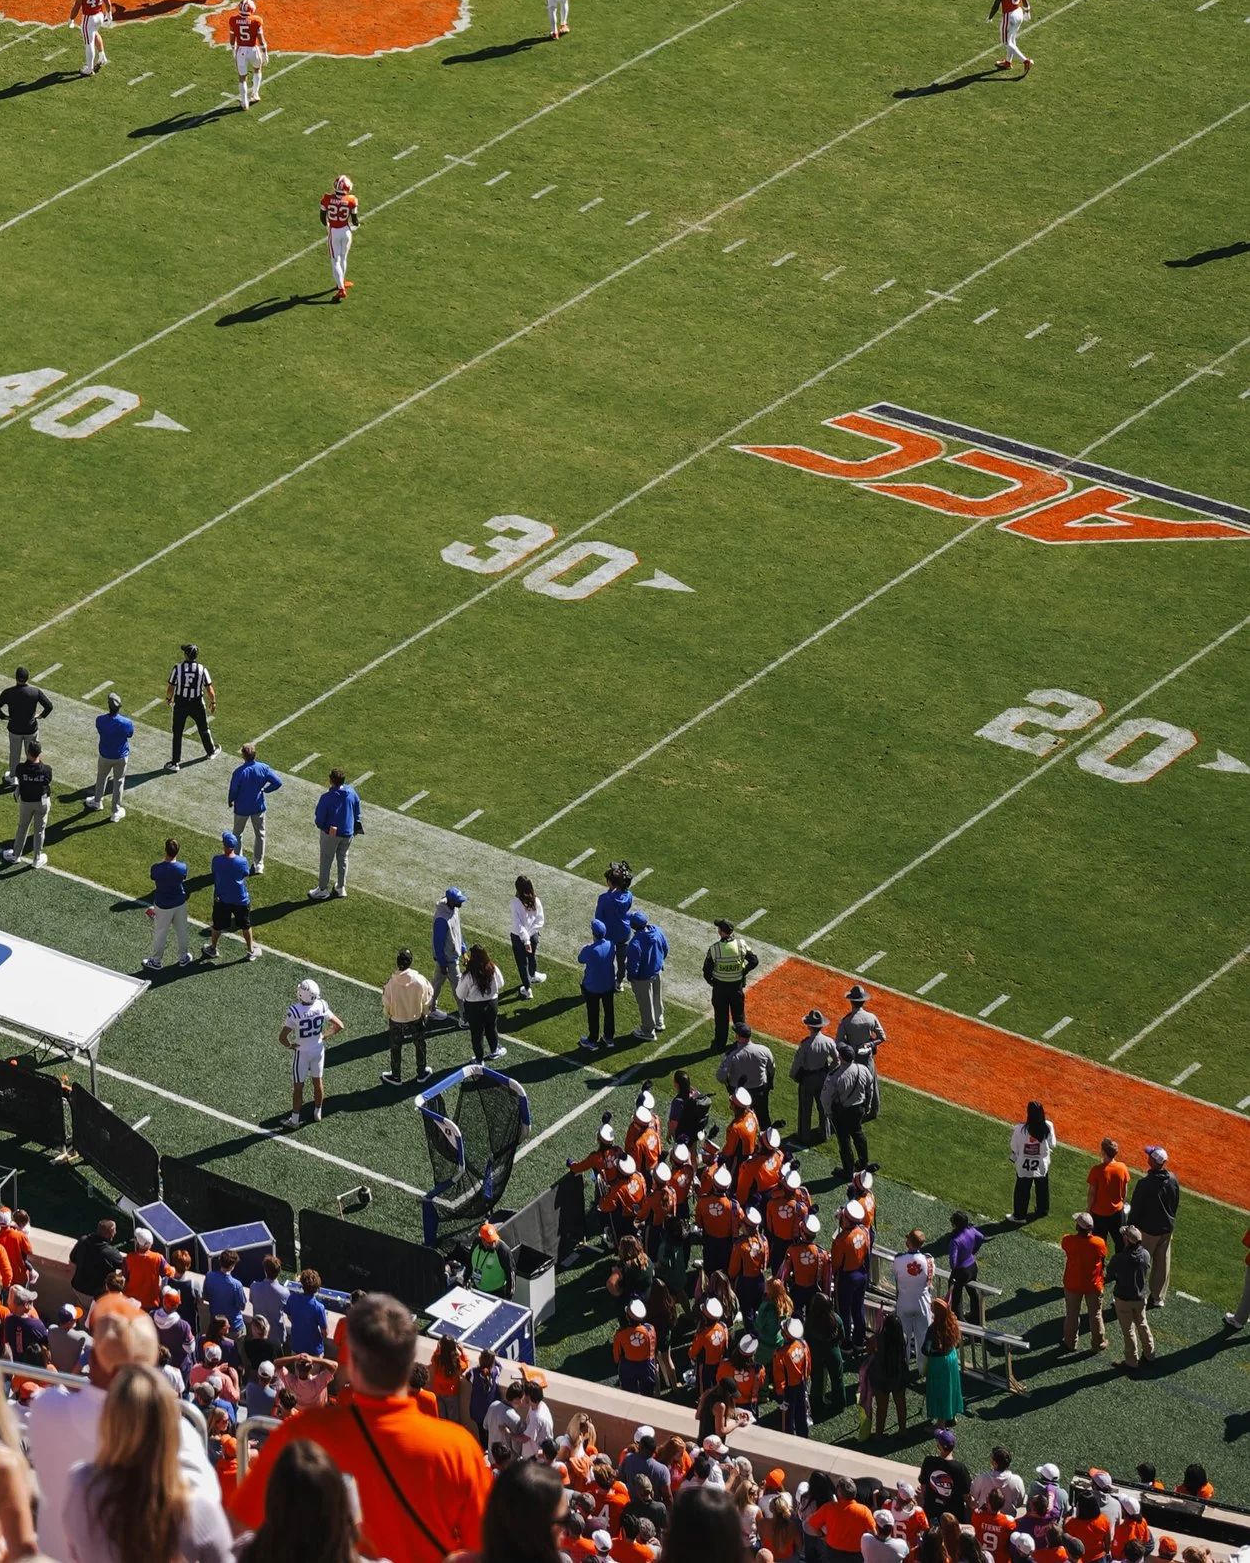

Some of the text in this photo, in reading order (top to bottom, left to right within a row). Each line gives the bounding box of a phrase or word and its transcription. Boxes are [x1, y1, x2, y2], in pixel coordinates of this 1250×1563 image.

[240, 24, 250, 40] 5
[327, 205, 349, 221] 23
[440, 512, 638, 599] 30
[184, 672, 195, 687] F
[980, 687, 1196, 782] 20
[23, 774, 45, 782] DUKE
[718, 964, 741, 972] SHERIFF
[299, 1020, 323, 1038] 29
[1022, 1159, 1040, 1171] 42
[451, 1299, 483, 1322] DELTA
[982, 1531, 999, 1552] 9
